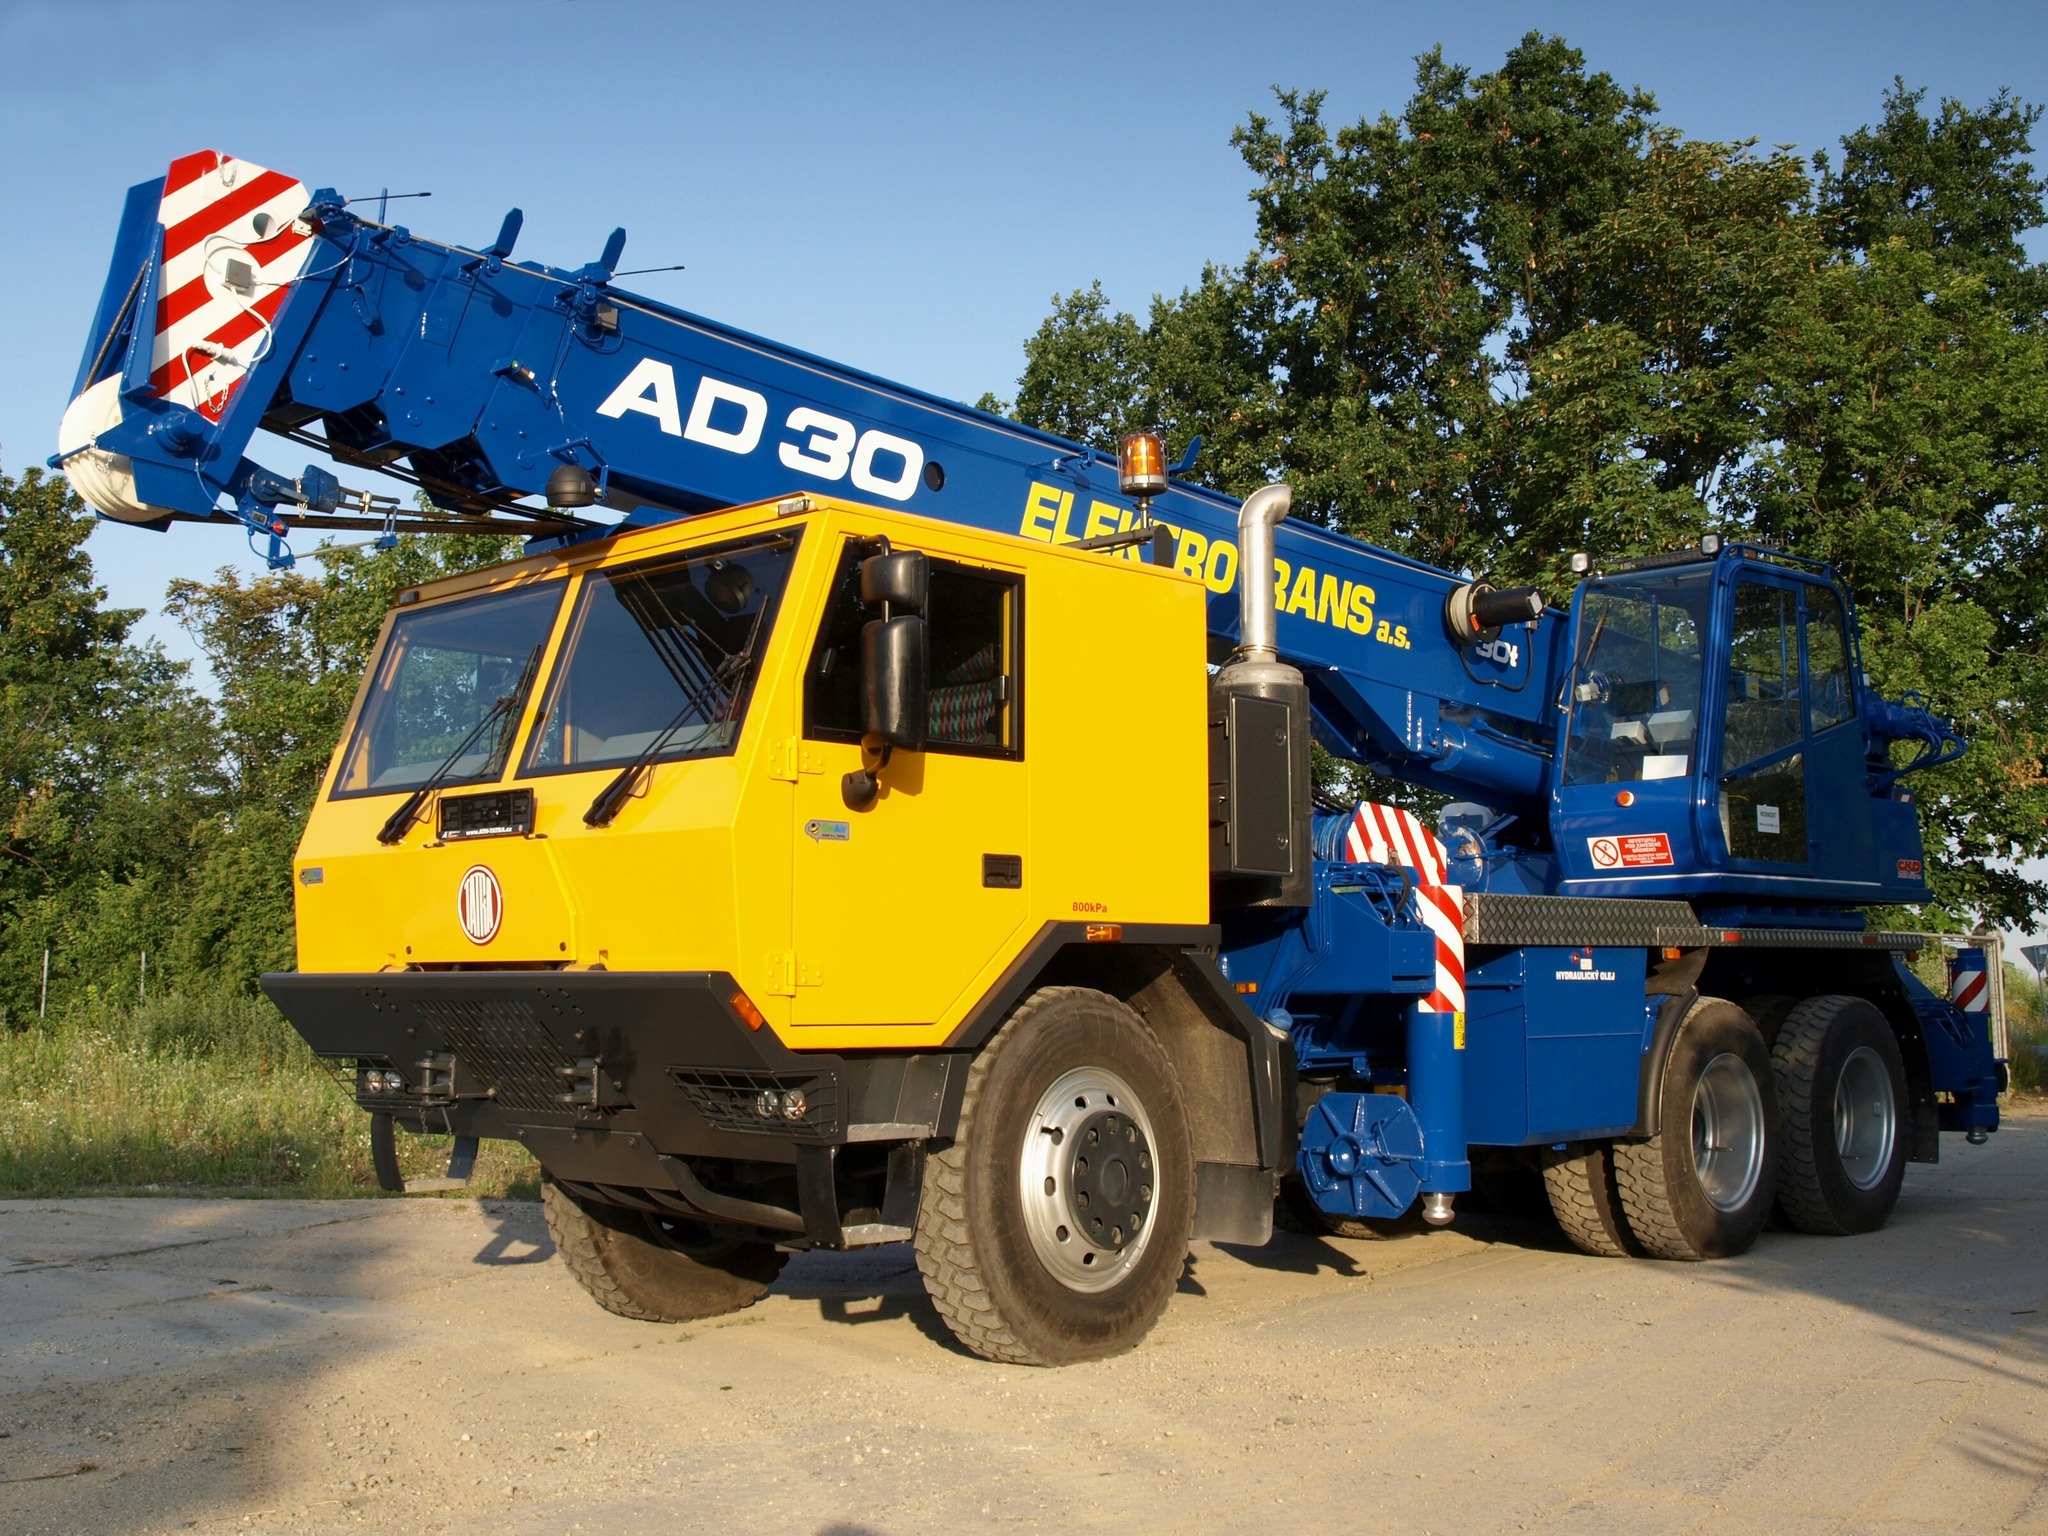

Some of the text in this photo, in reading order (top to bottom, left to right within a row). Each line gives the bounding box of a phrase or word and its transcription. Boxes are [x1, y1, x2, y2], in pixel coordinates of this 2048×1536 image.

[596, 357, 924, 501] AD 30
[1376, 620, 1411, 650] a.s.
[1072, 901, 1107, 913] 800kPa
[1600, 971, 1615, 981] OLEJ
